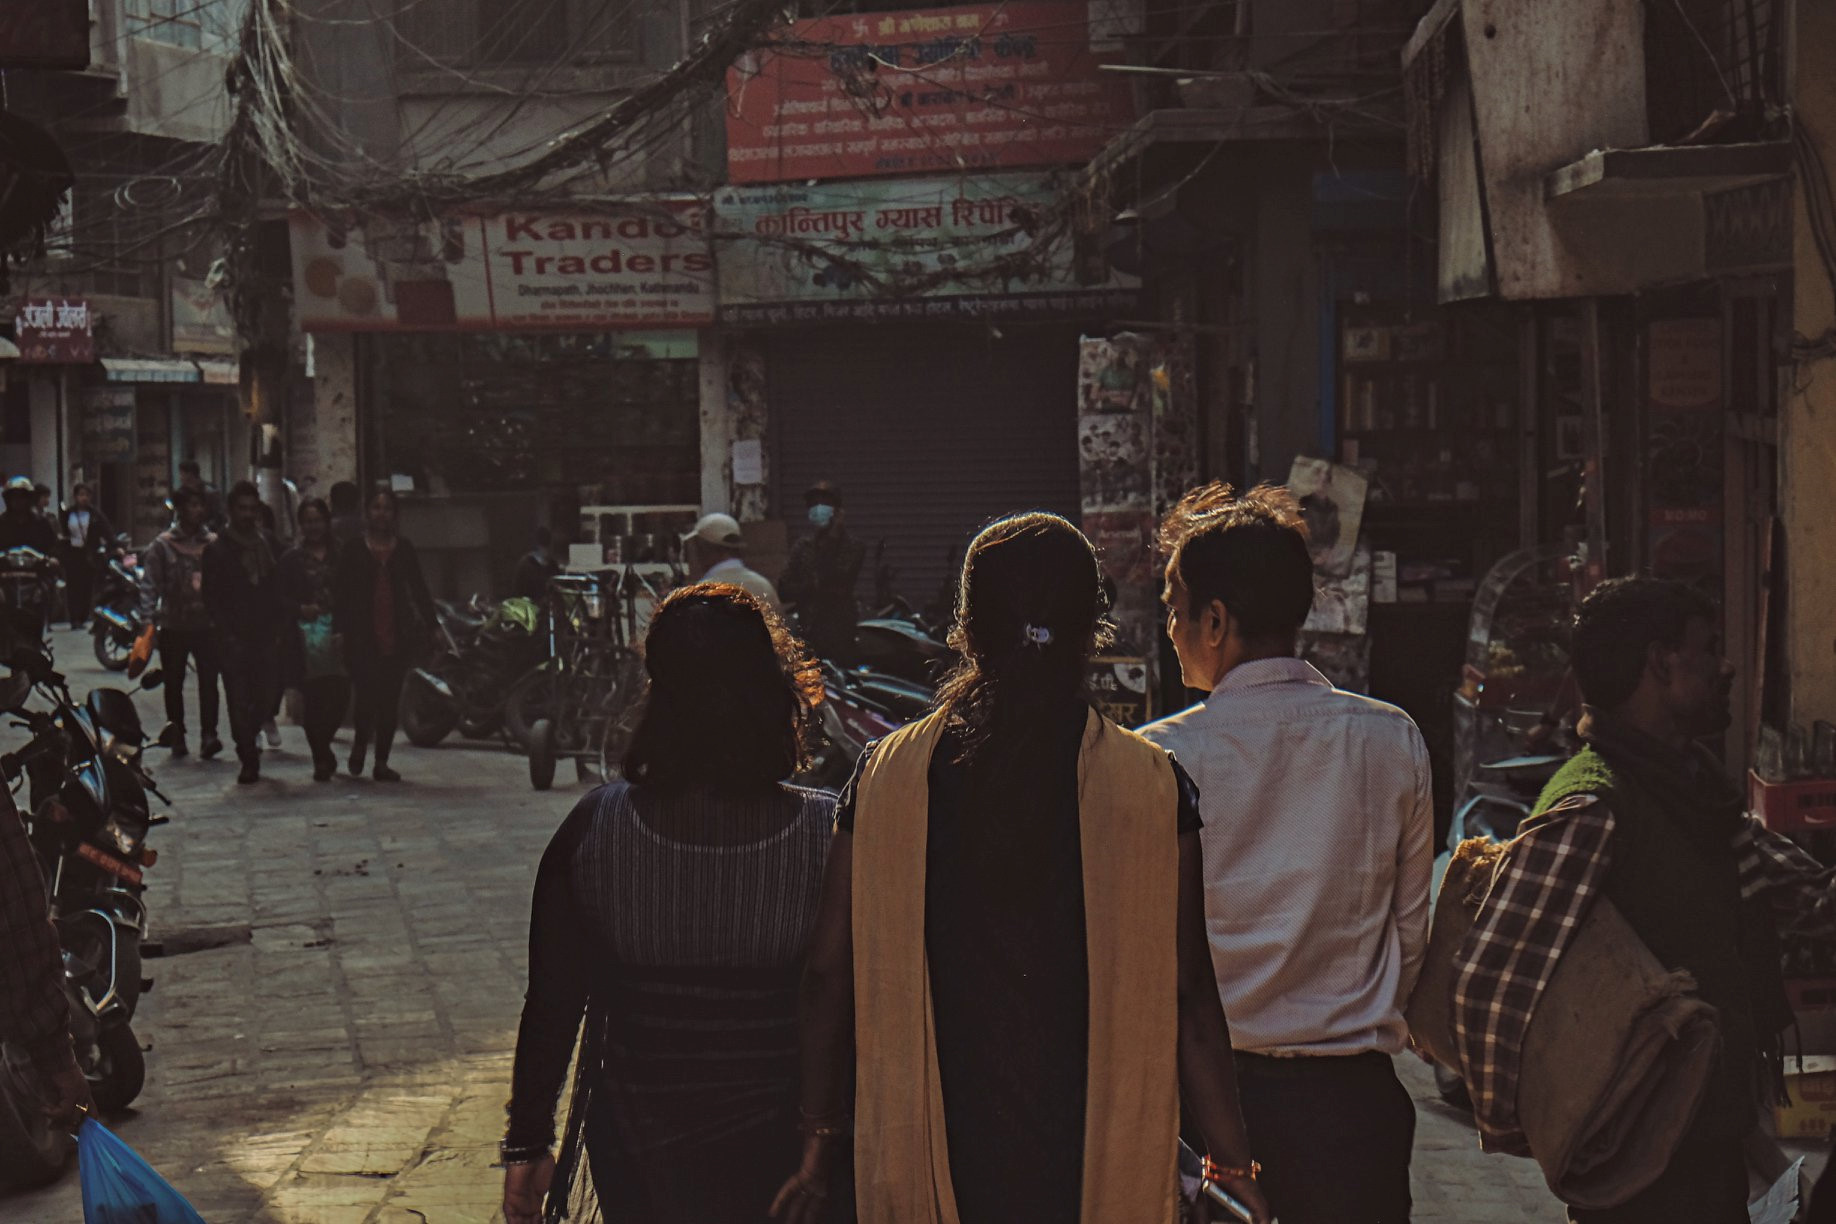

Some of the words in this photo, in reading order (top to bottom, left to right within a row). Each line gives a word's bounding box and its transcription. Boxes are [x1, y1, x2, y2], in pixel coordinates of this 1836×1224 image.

[755, 207, 865, 240] कान्तिपुर
[876, 206, 943, 230] ग्यास
[501, 249, 712, 275] Traders
